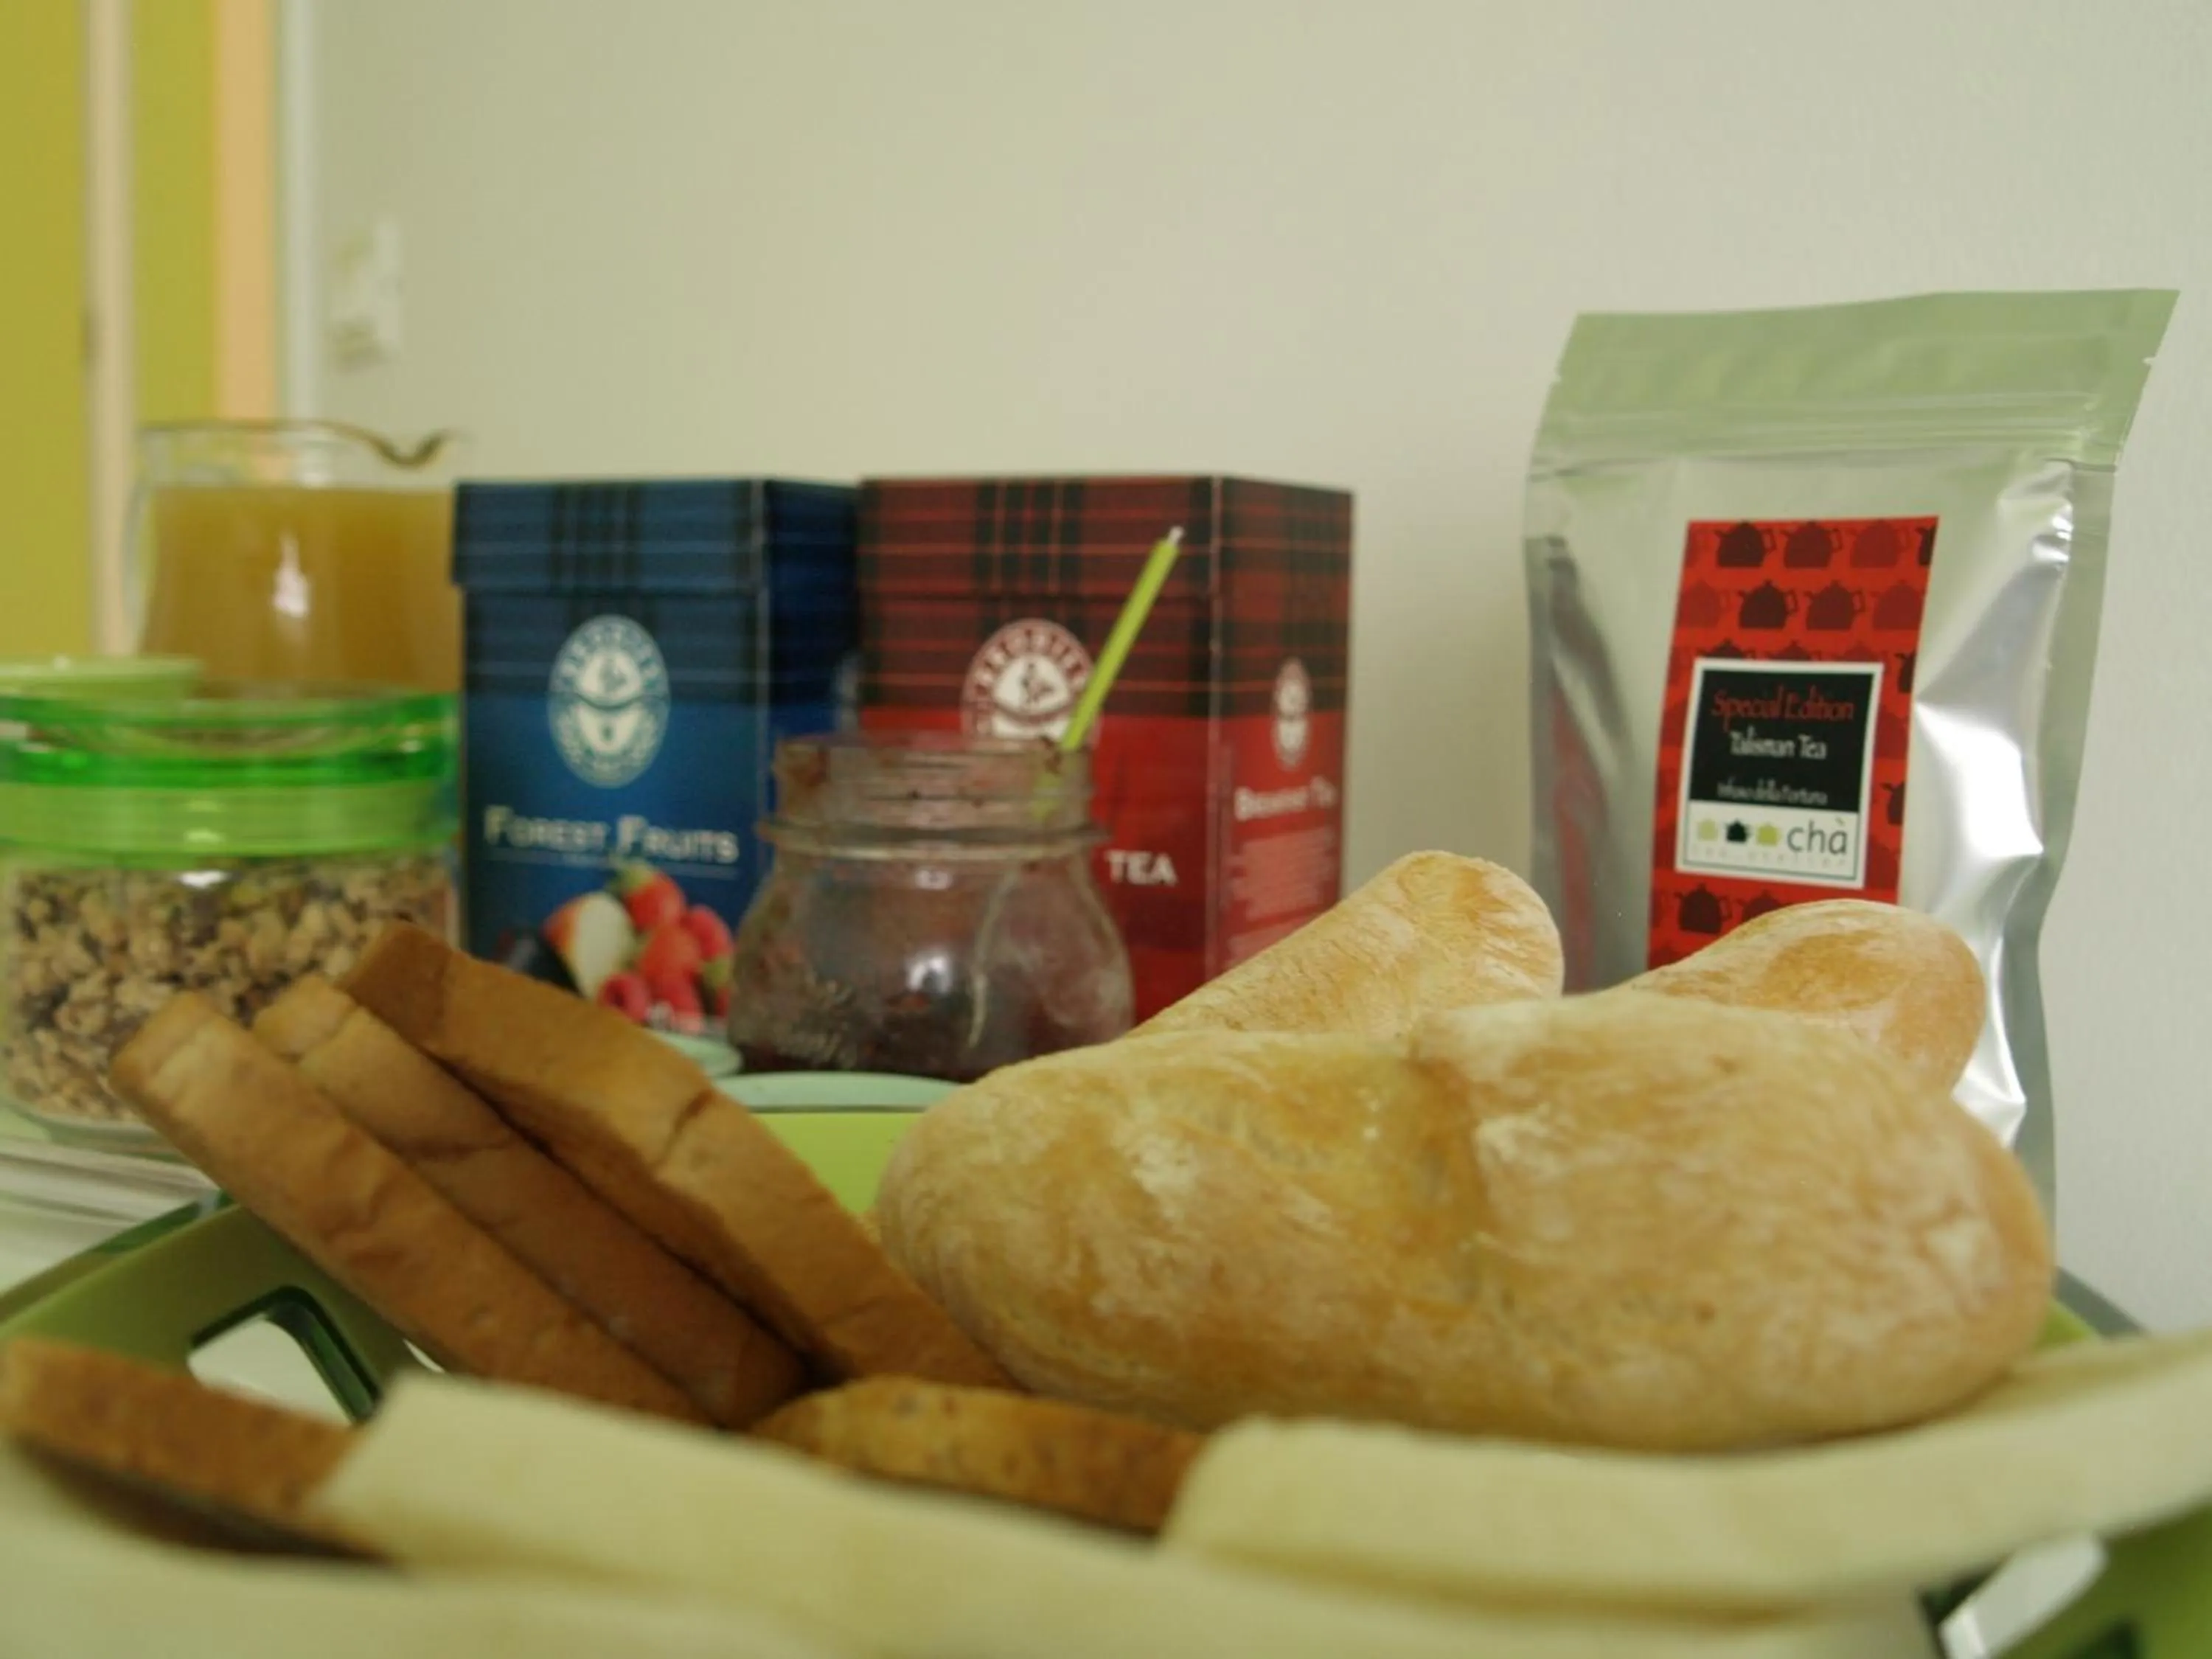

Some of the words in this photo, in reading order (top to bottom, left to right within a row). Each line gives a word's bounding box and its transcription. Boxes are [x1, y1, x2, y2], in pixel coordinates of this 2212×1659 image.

[1709, 684, 1784, 732] Special
[1798, 734, 1828, 759] Tea
[1787, 817, 1848, 855] chà
[1107, 850, 1176, 885] TEA
